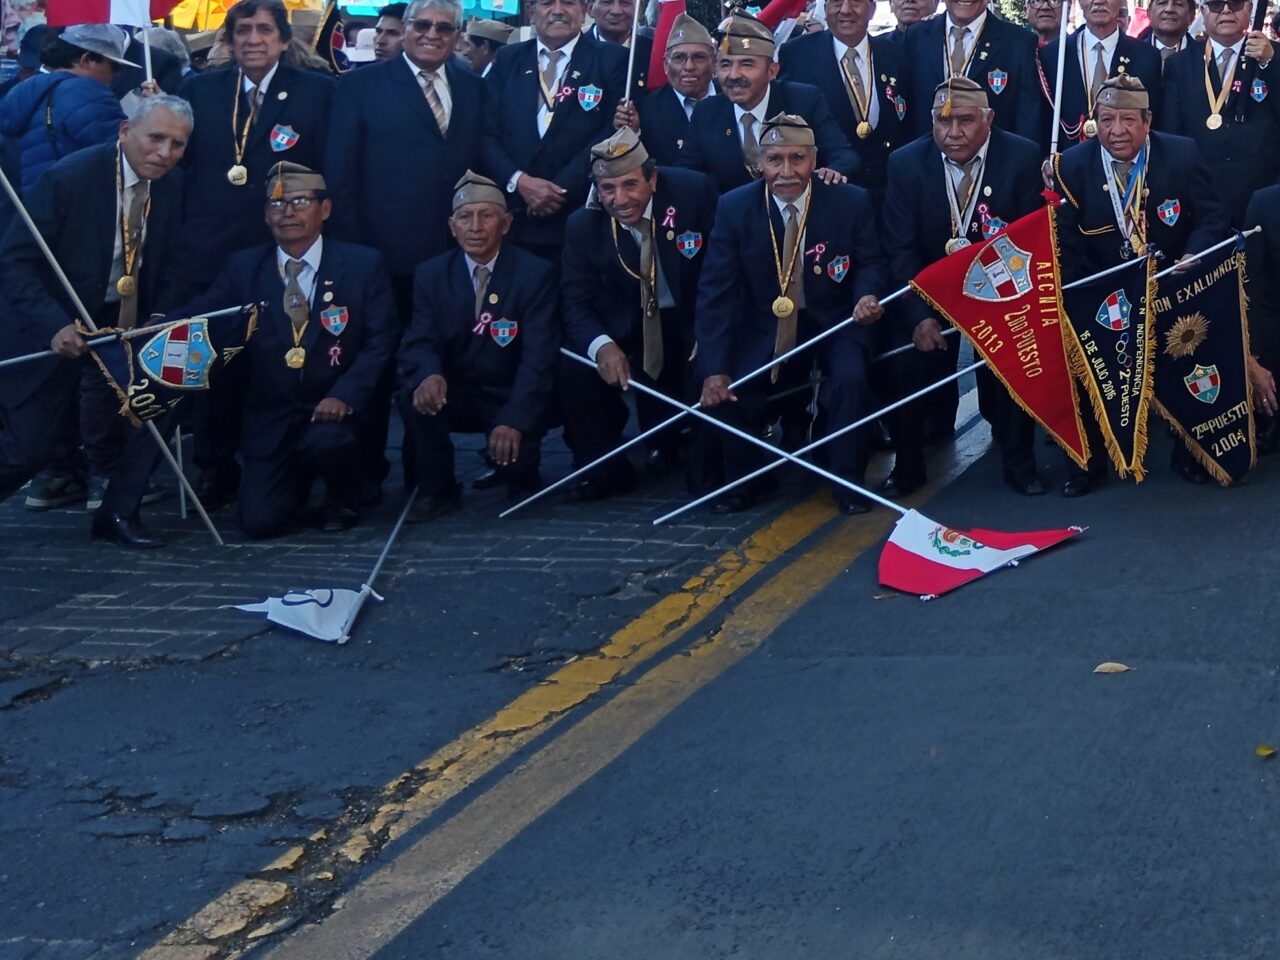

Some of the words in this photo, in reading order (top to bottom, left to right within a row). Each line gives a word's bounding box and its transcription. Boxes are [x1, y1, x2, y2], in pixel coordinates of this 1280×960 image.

[1177, 254, 1239, 303] EXALUMNOS
[970, 319, 1004, 354] 2013
[1079, 330, 1091, 341] 15
[1084, 340, 1098, 356] DE
[1012, 328, 1044, 379] PUESTO
[1091, 357, 1109, 381] JULIO
[1131, 323, 1145, 397] INDEPENDENCIA
[1101, 380, 1117, 401] 2016
[1120, 384, 1130, 427] PUESTO
[1208, 400, 1248, 433] PUESTO
